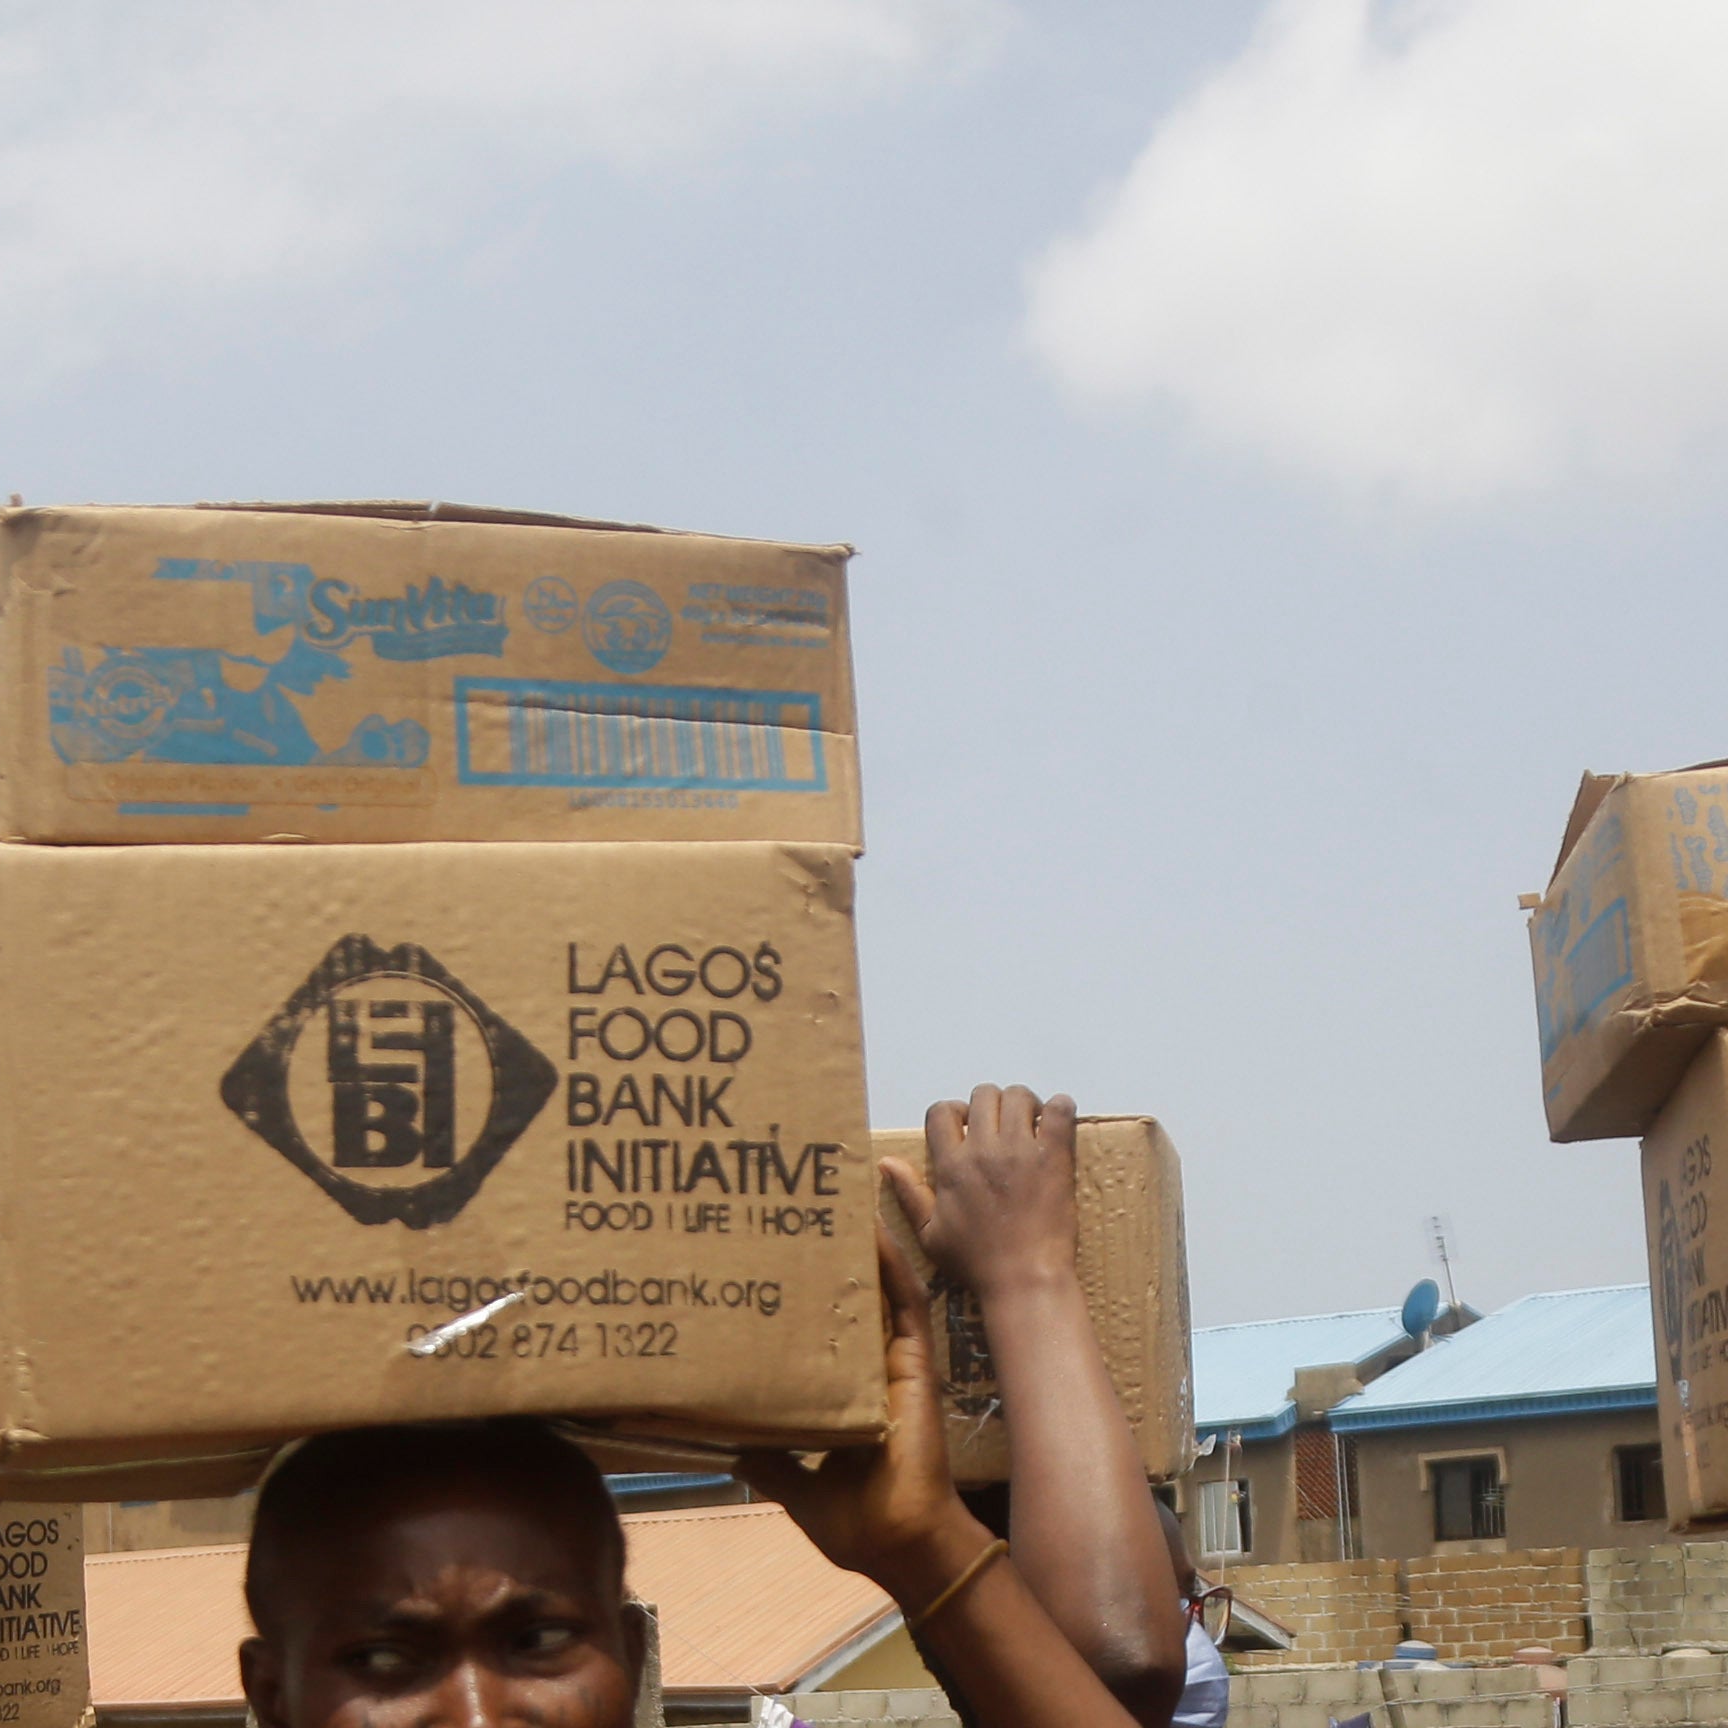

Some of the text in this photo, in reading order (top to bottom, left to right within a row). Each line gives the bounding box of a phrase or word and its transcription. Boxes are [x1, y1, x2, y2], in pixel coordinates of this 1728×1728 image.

[566, 941, 783, 1001] LAGOS
[567, 1005, 753, 1063] FOOD
[566, 1072, 735, 1128] BANK
[566, 1136, 843, 1196] INITIATIVE
[565, 1201, 654, 1231] FOOD
[761, 1205, 835, 1237] HOPE
[290, 1269, 783, 1316] www.lagosfoodbank.org
[512, 1323, 579, 1358] 874
[599, 1322, 679, 1358] 1322
[52, 1641, 80, 1657] HOPE
